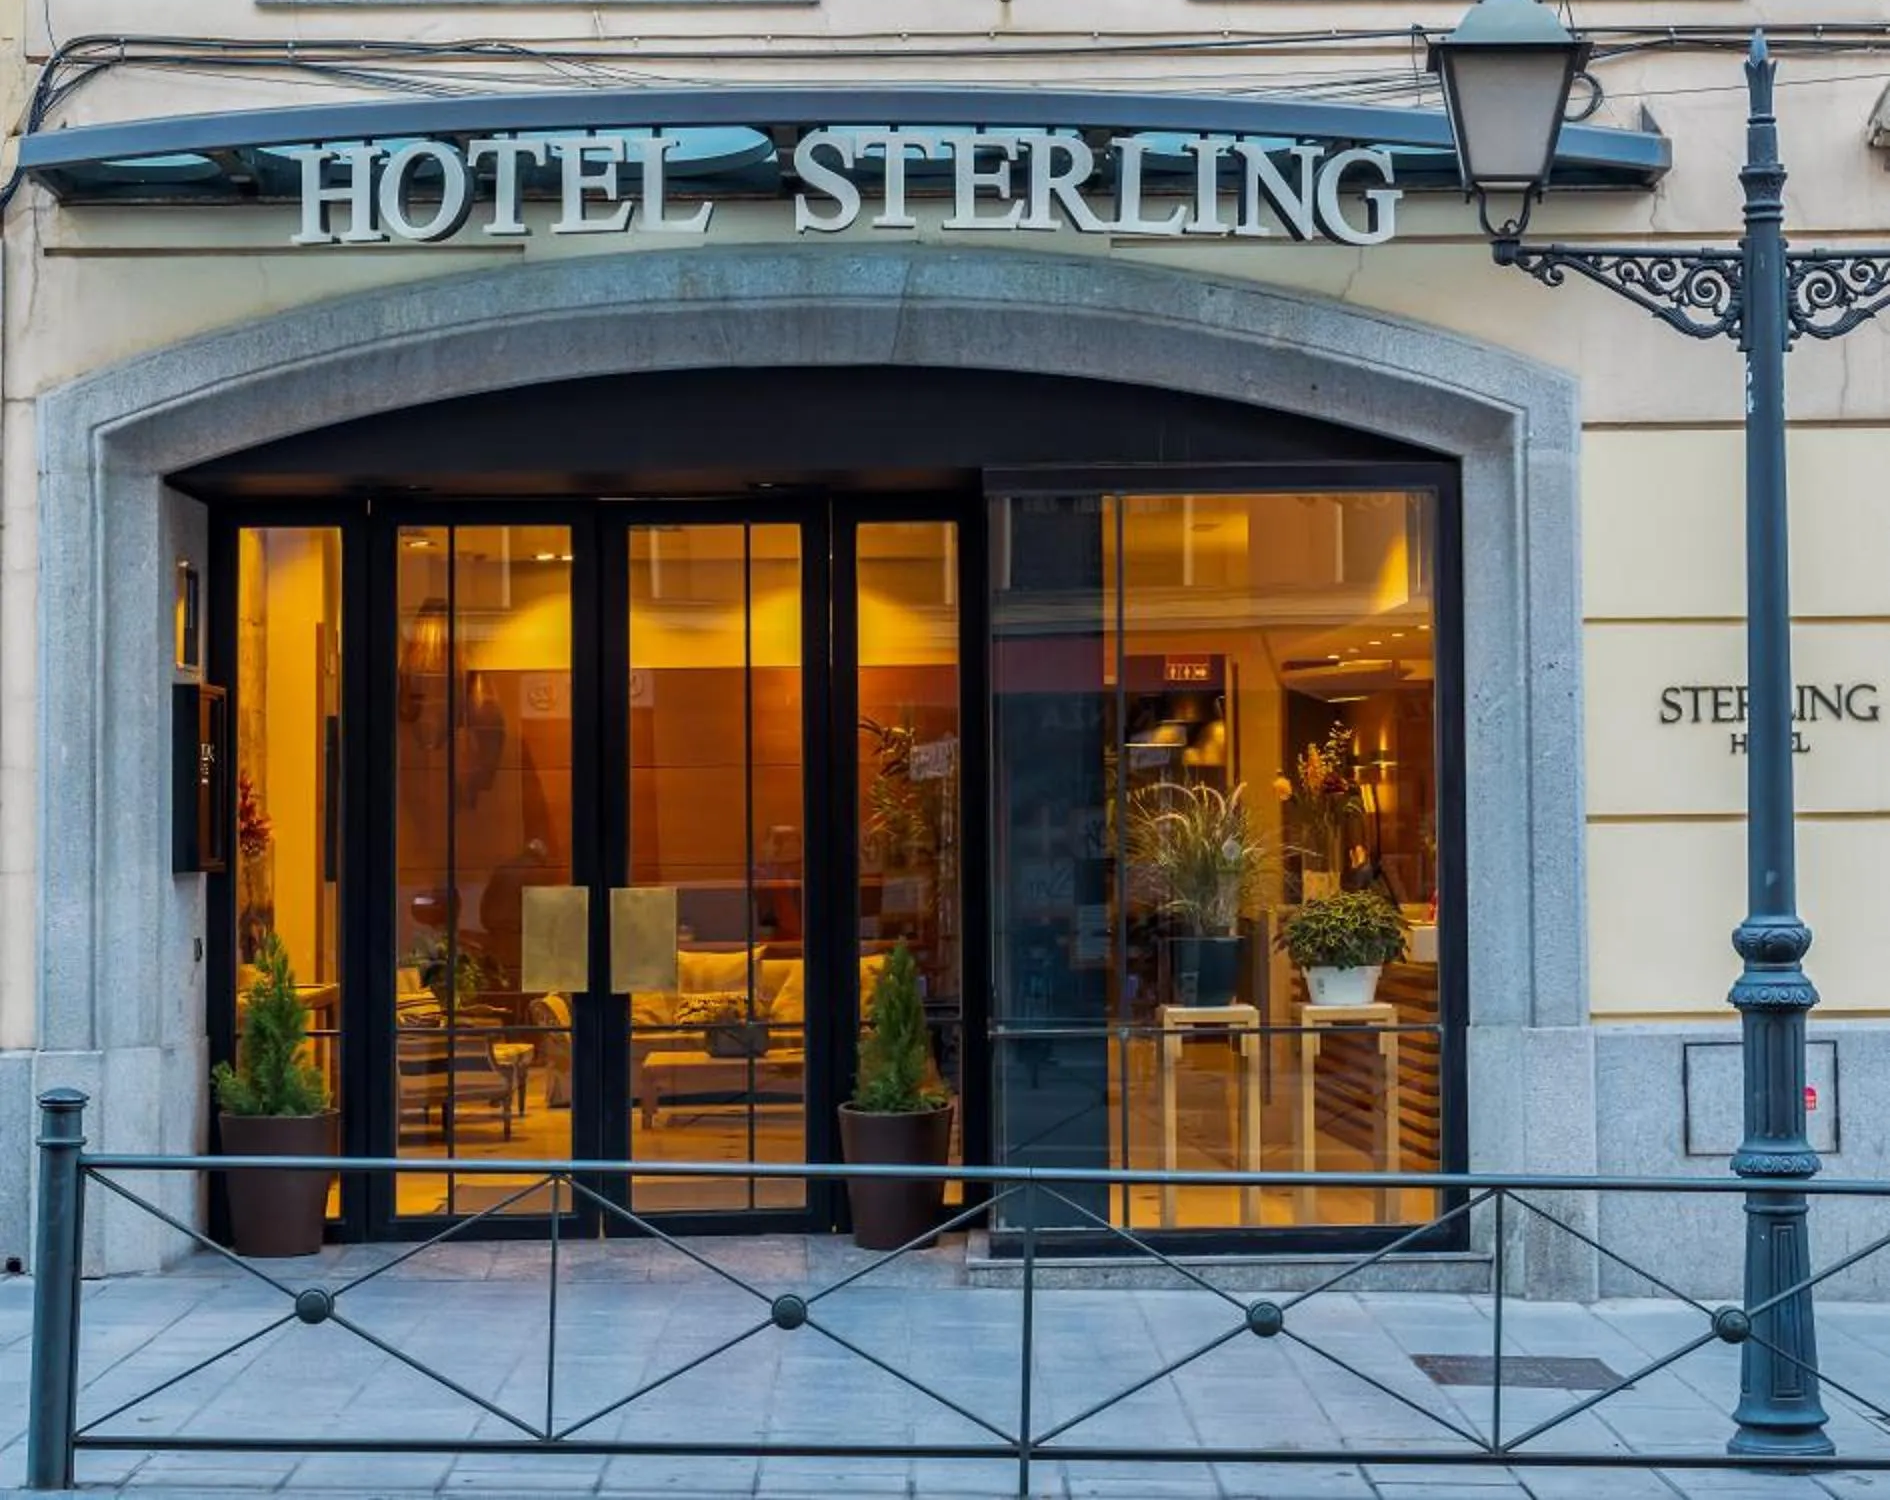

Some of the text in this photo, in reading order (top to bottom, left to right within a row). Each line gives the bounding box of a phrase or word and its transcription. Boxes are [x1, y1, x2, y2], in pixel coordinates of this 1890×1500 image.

[290, 126, 1404, 246] HOTEL STERLING
[1660, 684, 1880, 724] STEING
